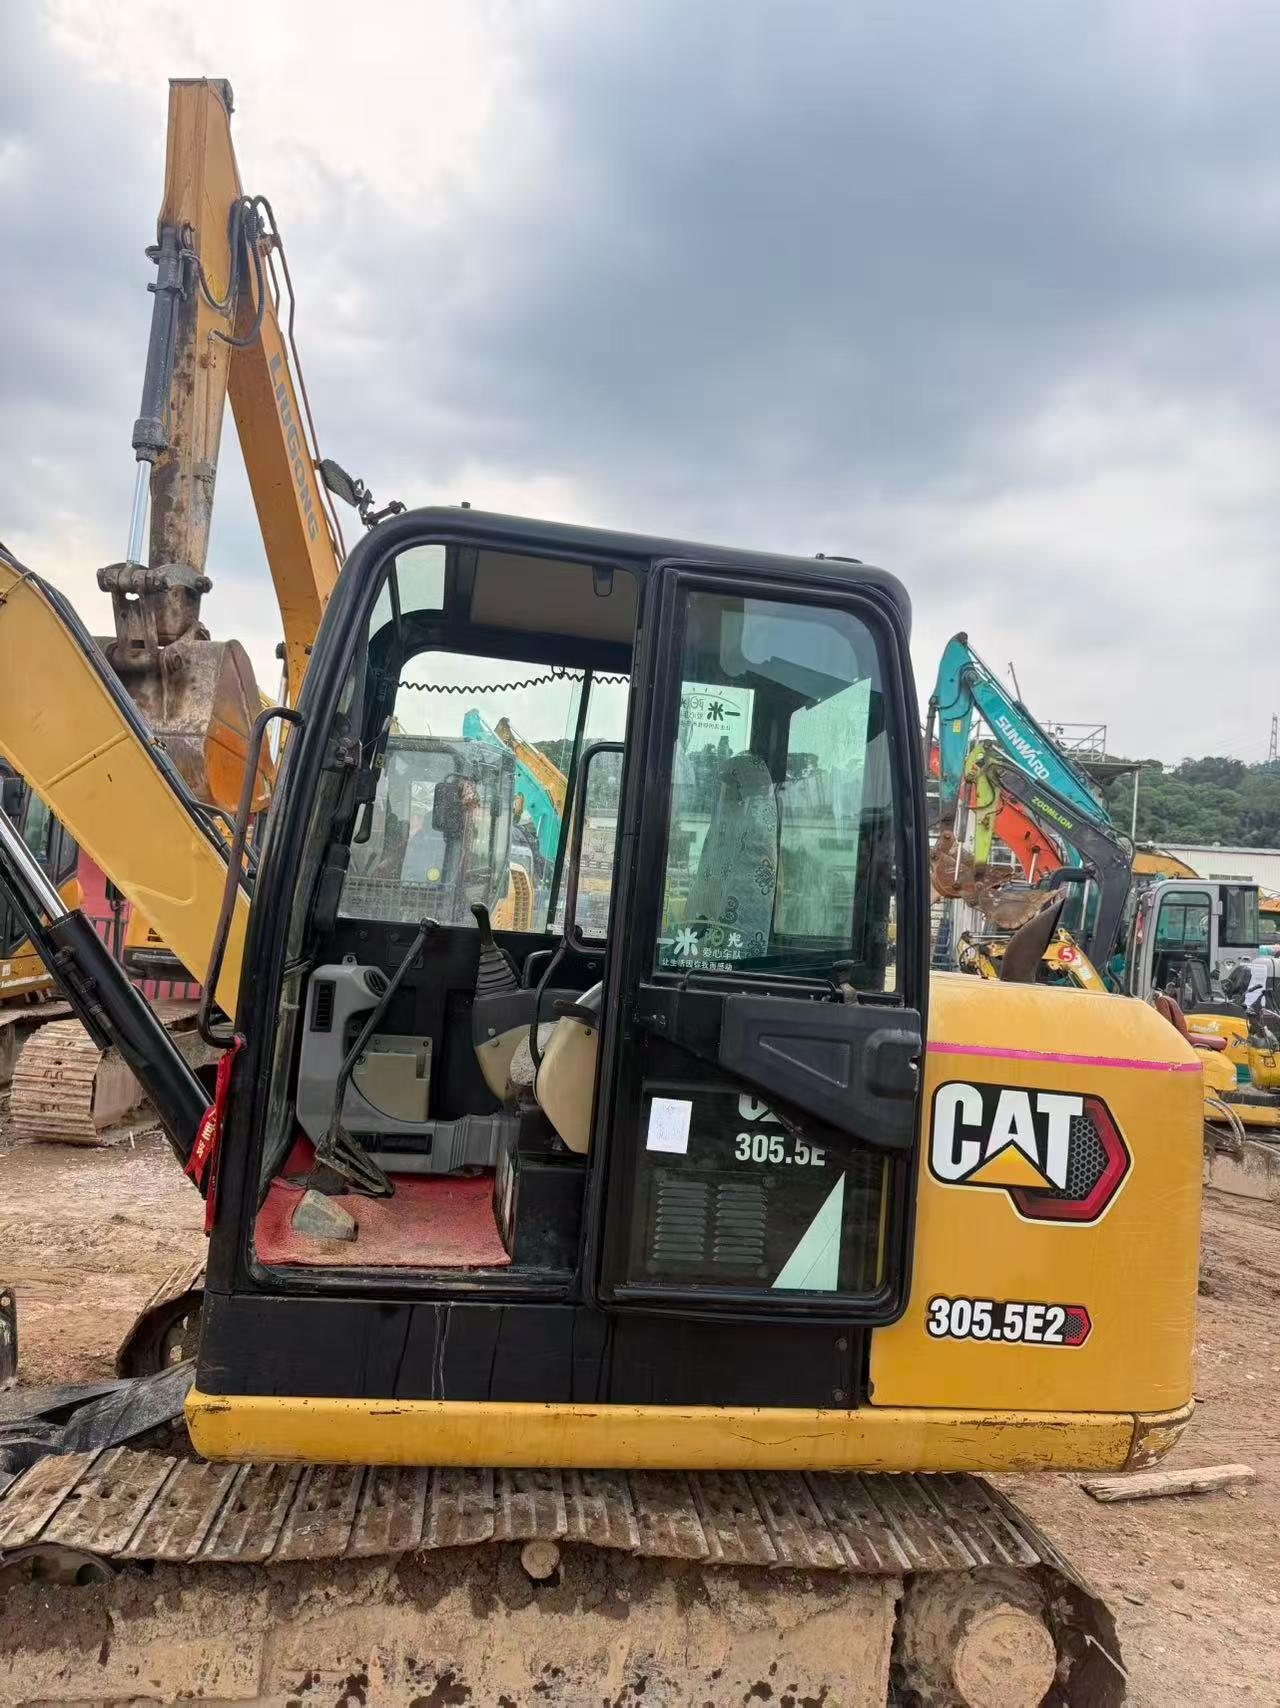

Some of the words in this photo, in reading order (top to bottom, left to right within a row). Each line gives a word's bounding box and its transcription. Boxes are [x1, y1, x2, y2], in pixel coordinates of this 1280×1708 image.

[271, 353, 317, 541] LIUGONG
[996, 716, 1050, 780] SUNWARD
[1031, 796, 1073, 829] ZOOMLION
[1062, 947, 1073, 962] 5
[932, 1083, 1084, 1190] CAT
[929, 1298, 1066, 1343] 305.5E2
